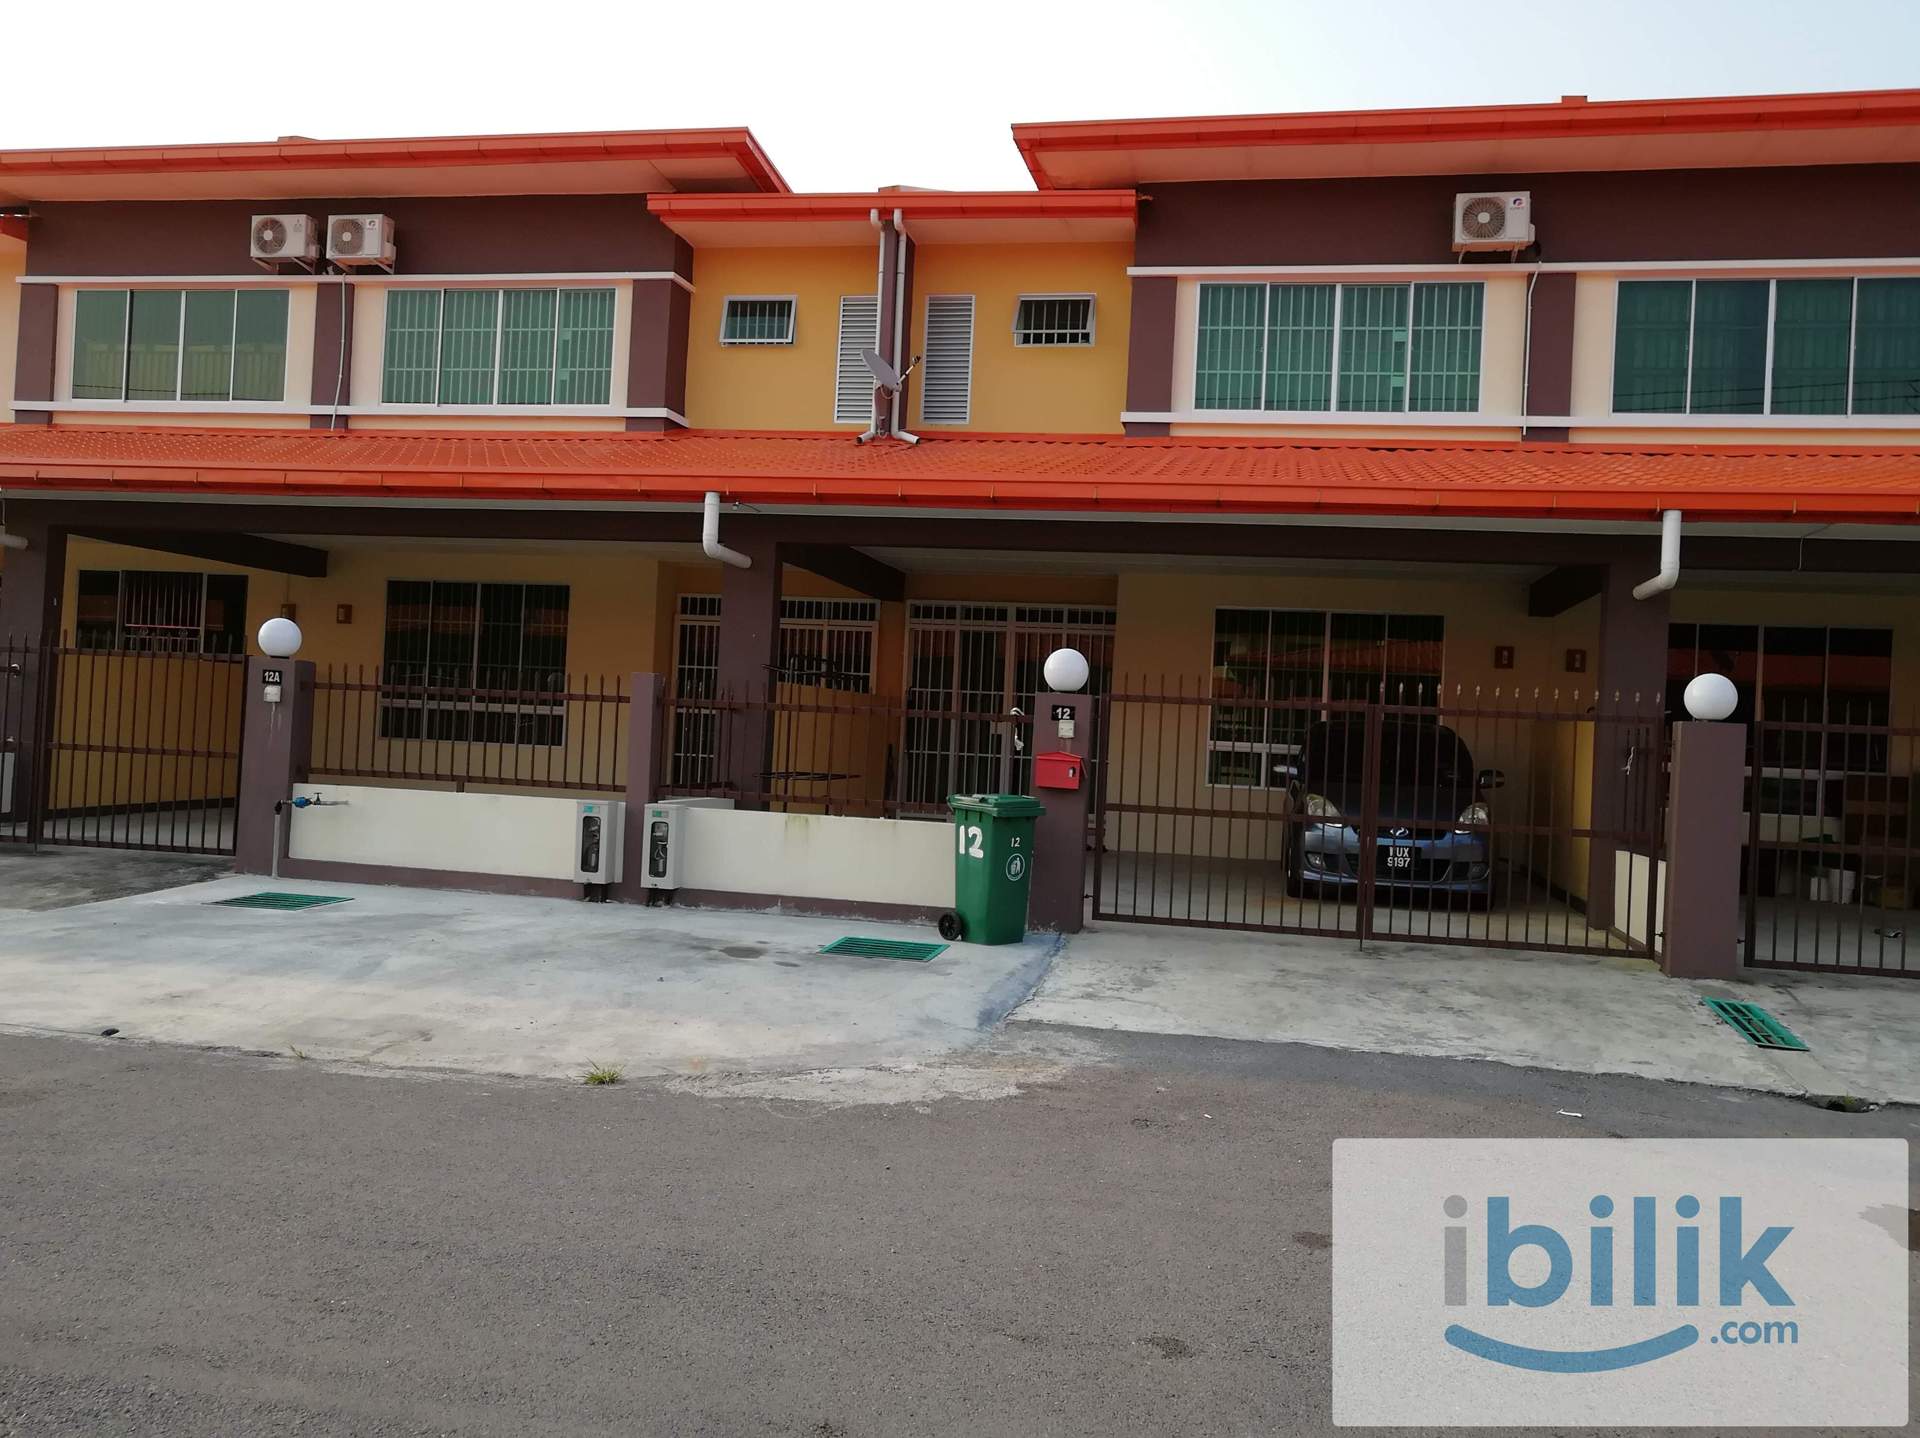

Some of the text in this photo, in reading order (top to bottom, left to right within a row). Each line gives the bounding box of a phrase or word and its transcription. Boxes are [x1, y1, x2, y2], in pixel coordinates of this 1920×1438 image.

[264, 671, 280, 682] 12A
[1056, 707, 1070, 719] 12
[959, 825, 984, 859] 12
[1011, 837, 1021, 847] 12
[1387, 857, 1410, 867] 9197
